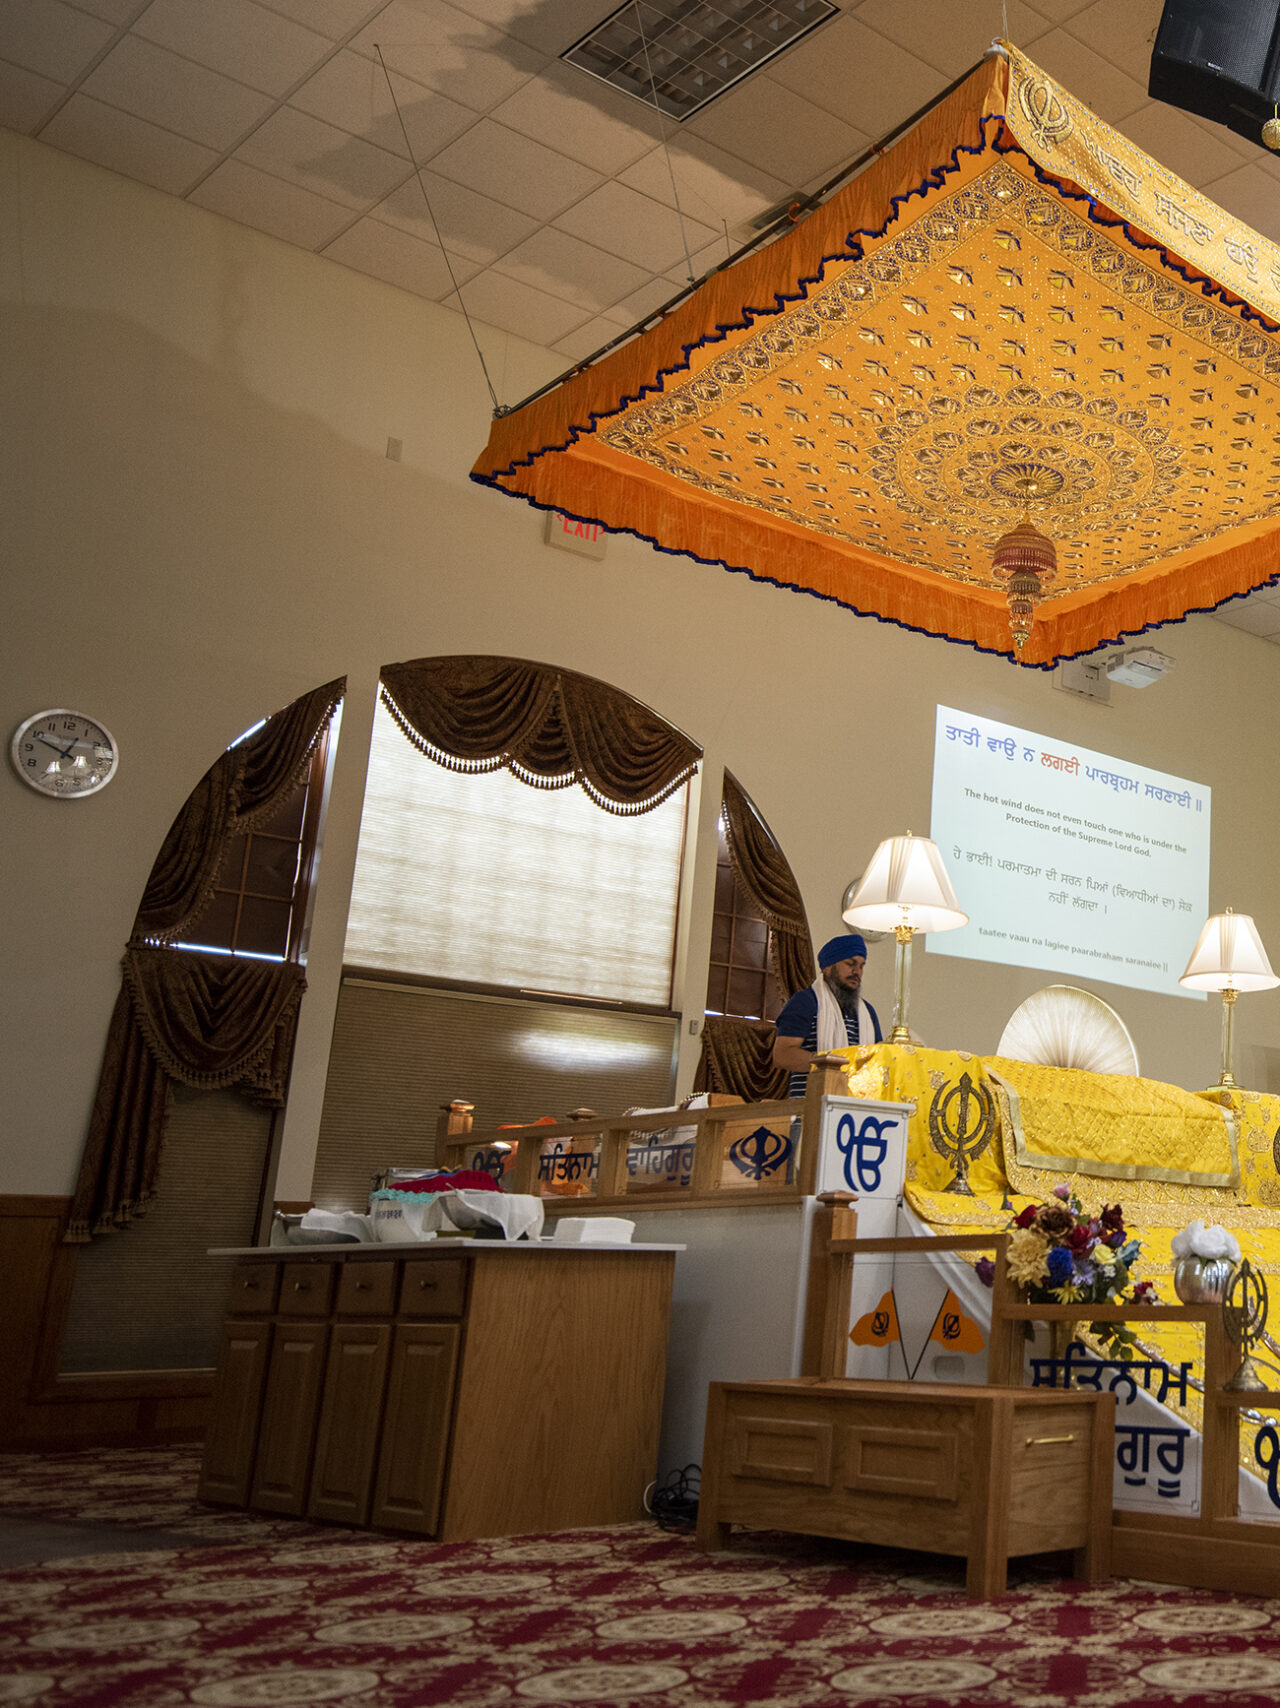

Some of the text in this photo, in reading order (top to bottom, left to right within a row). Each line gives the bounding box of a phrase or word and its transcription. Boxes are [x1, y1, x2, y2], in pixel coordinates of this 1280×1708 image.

[33, 730, 45, 739] 10
[48, 722, 56, 732] 11
[63, 721, 76, 731] 12
[25, 743, 34, 752] 9
[27, 758, 37, 767] 8
[945, 724, 981, 748] ਤਾਤੀ
[987, 735, 1017, 761] ਵਾਉ
[1023, 747, 1035, 762] ਨ
[1040, 751, 1080, 776] ਲਗਈ
[1144, 783, 1192, 809] ਸਰਣਾਈ
[964, 788, 1187, 854] The hot wind does not even touch one who is under the
[1005, 813, 1151, 858] Protection of the Supreme Lord God.
[979, 927, 1007, 939] taatee
[1009, 934, 1030, 945] vaau
[1032, 937, 1043, 946] na
[626, 1136, 696, 1186] ਵਾਹਿਗੁਰੂ
[836, 1113, 899, 1192] ੴ
